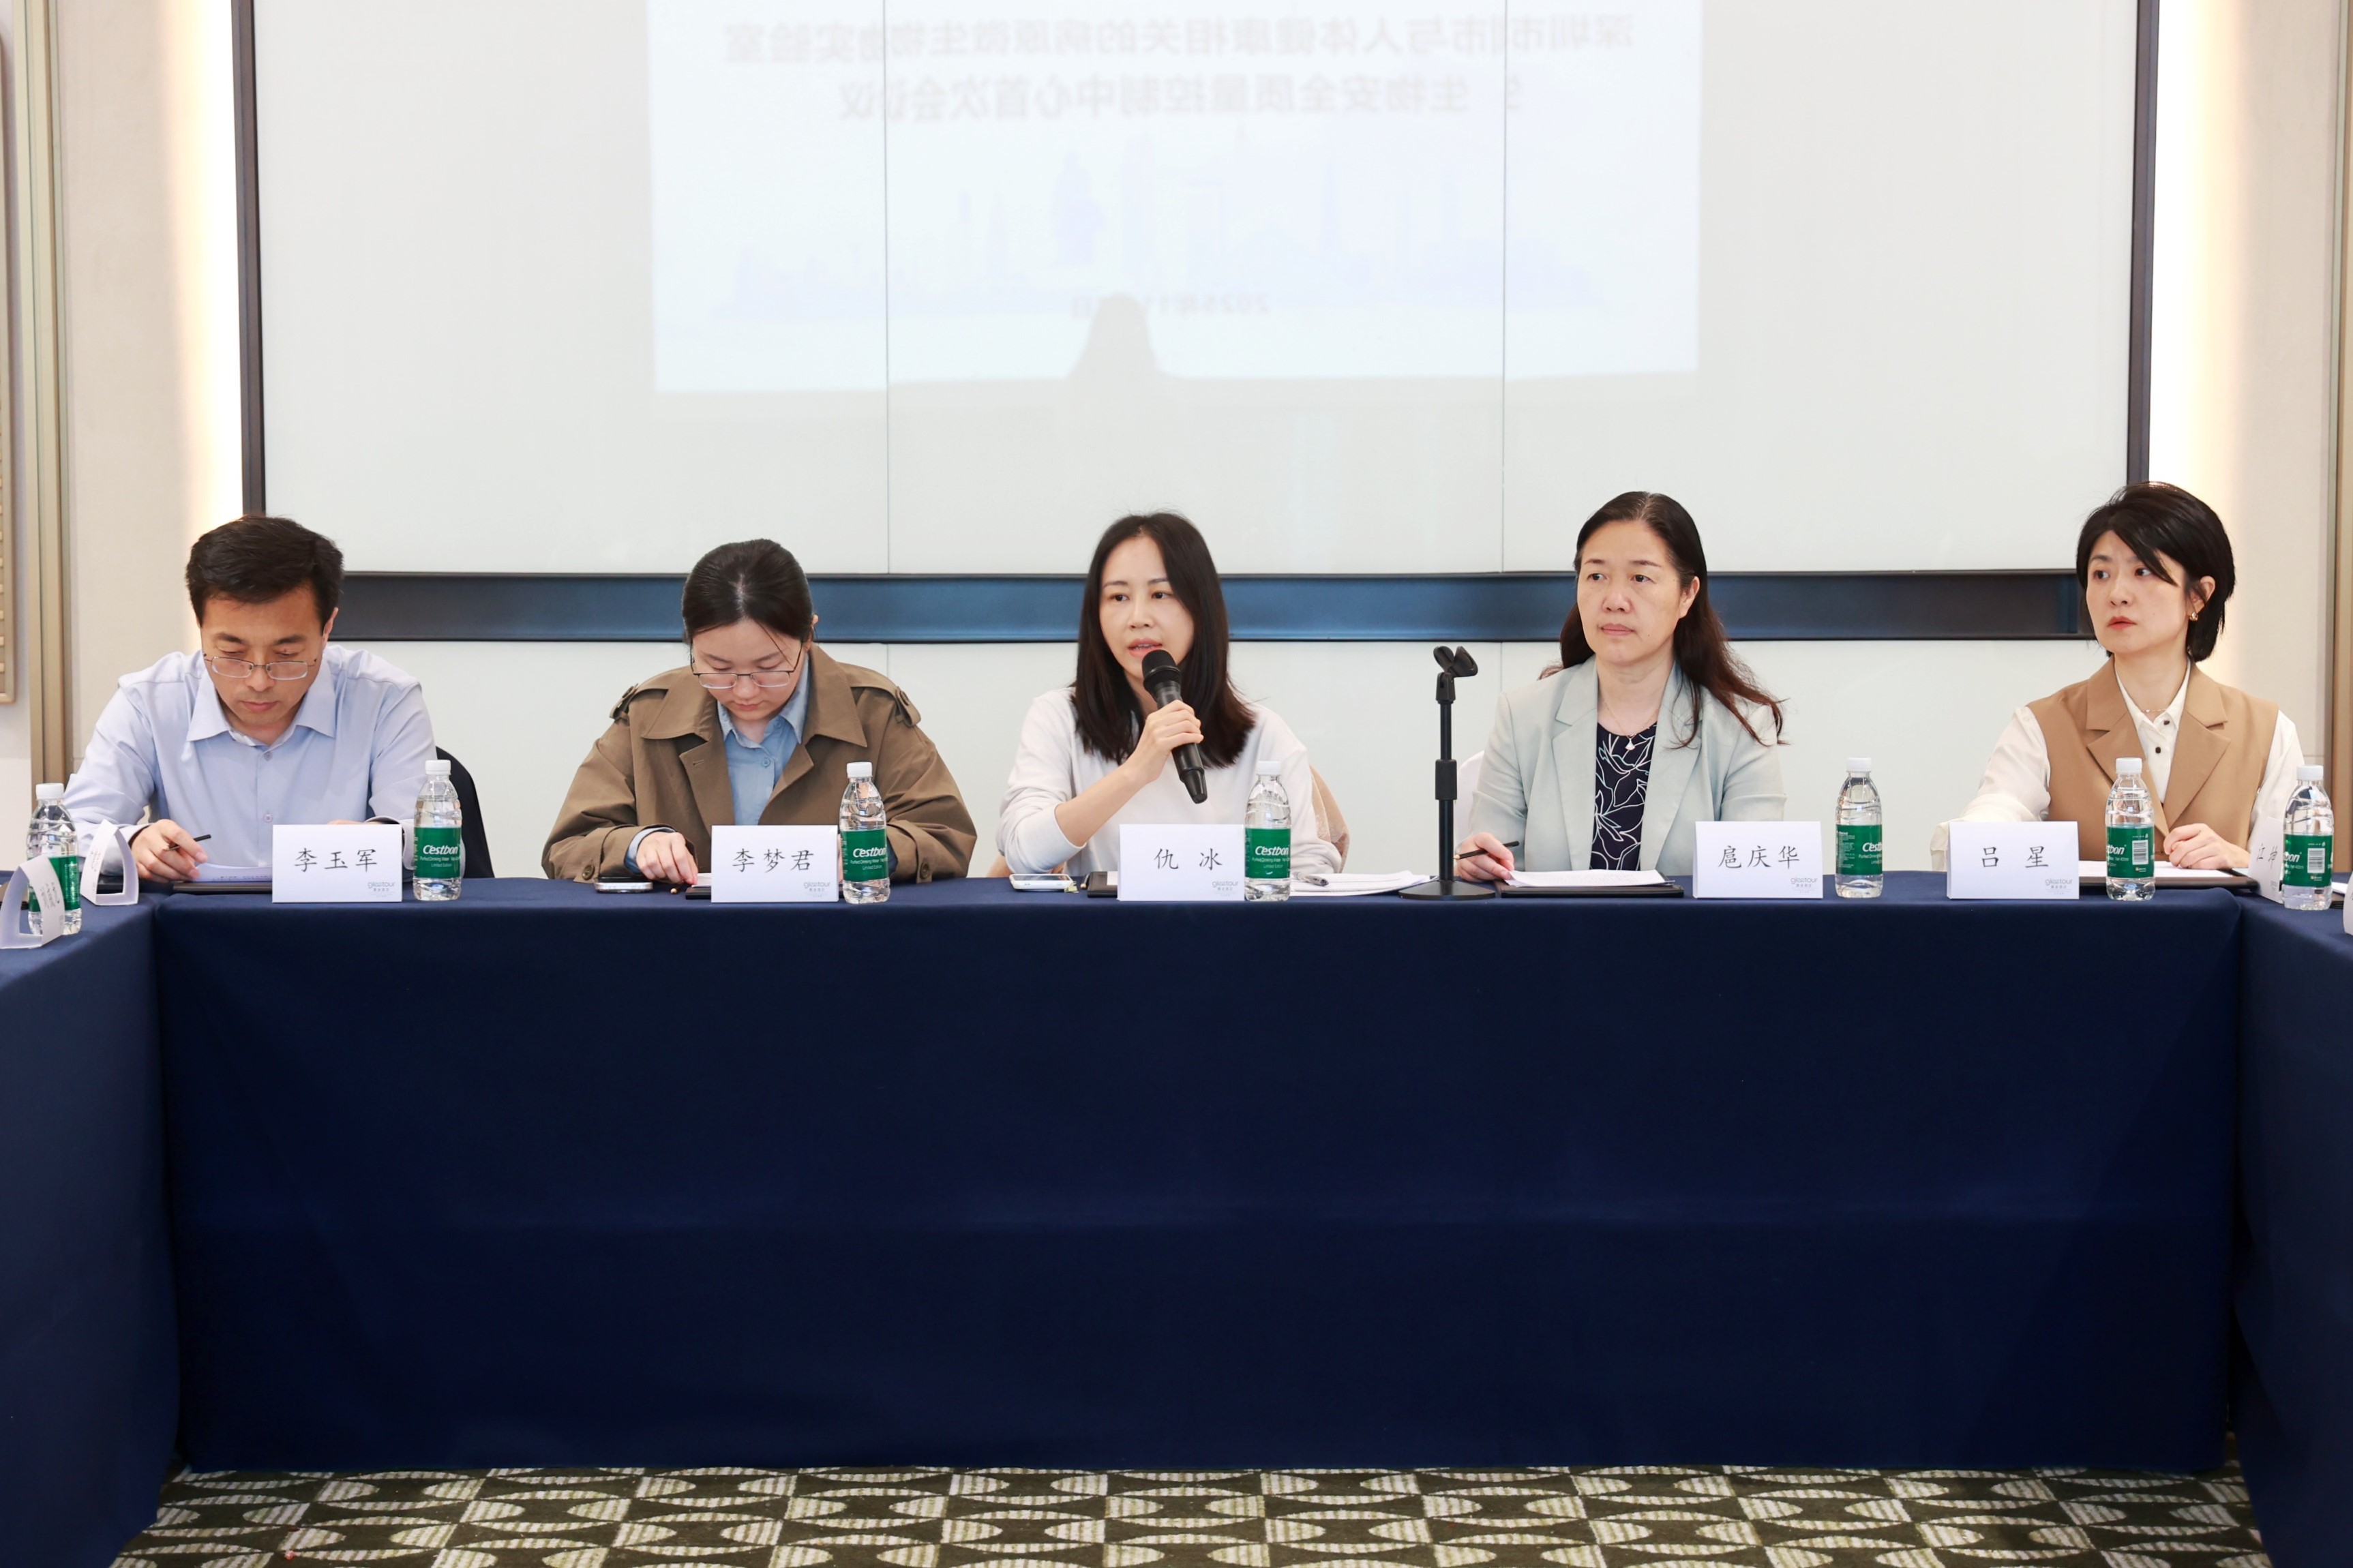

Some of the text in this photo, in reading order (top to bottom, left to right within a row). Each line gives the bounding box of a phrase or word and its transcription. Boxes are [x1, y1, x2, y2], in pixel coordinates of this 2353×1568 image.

[294, 847, 377, 872] 李玉军
[732, 848, 814, 873] 李梦君
[1153, 847, 1223, 871] 仇冰
[1718, 845, 1800, 869] 扈庆华
[1981, 845, 2049, 869] 吕星
